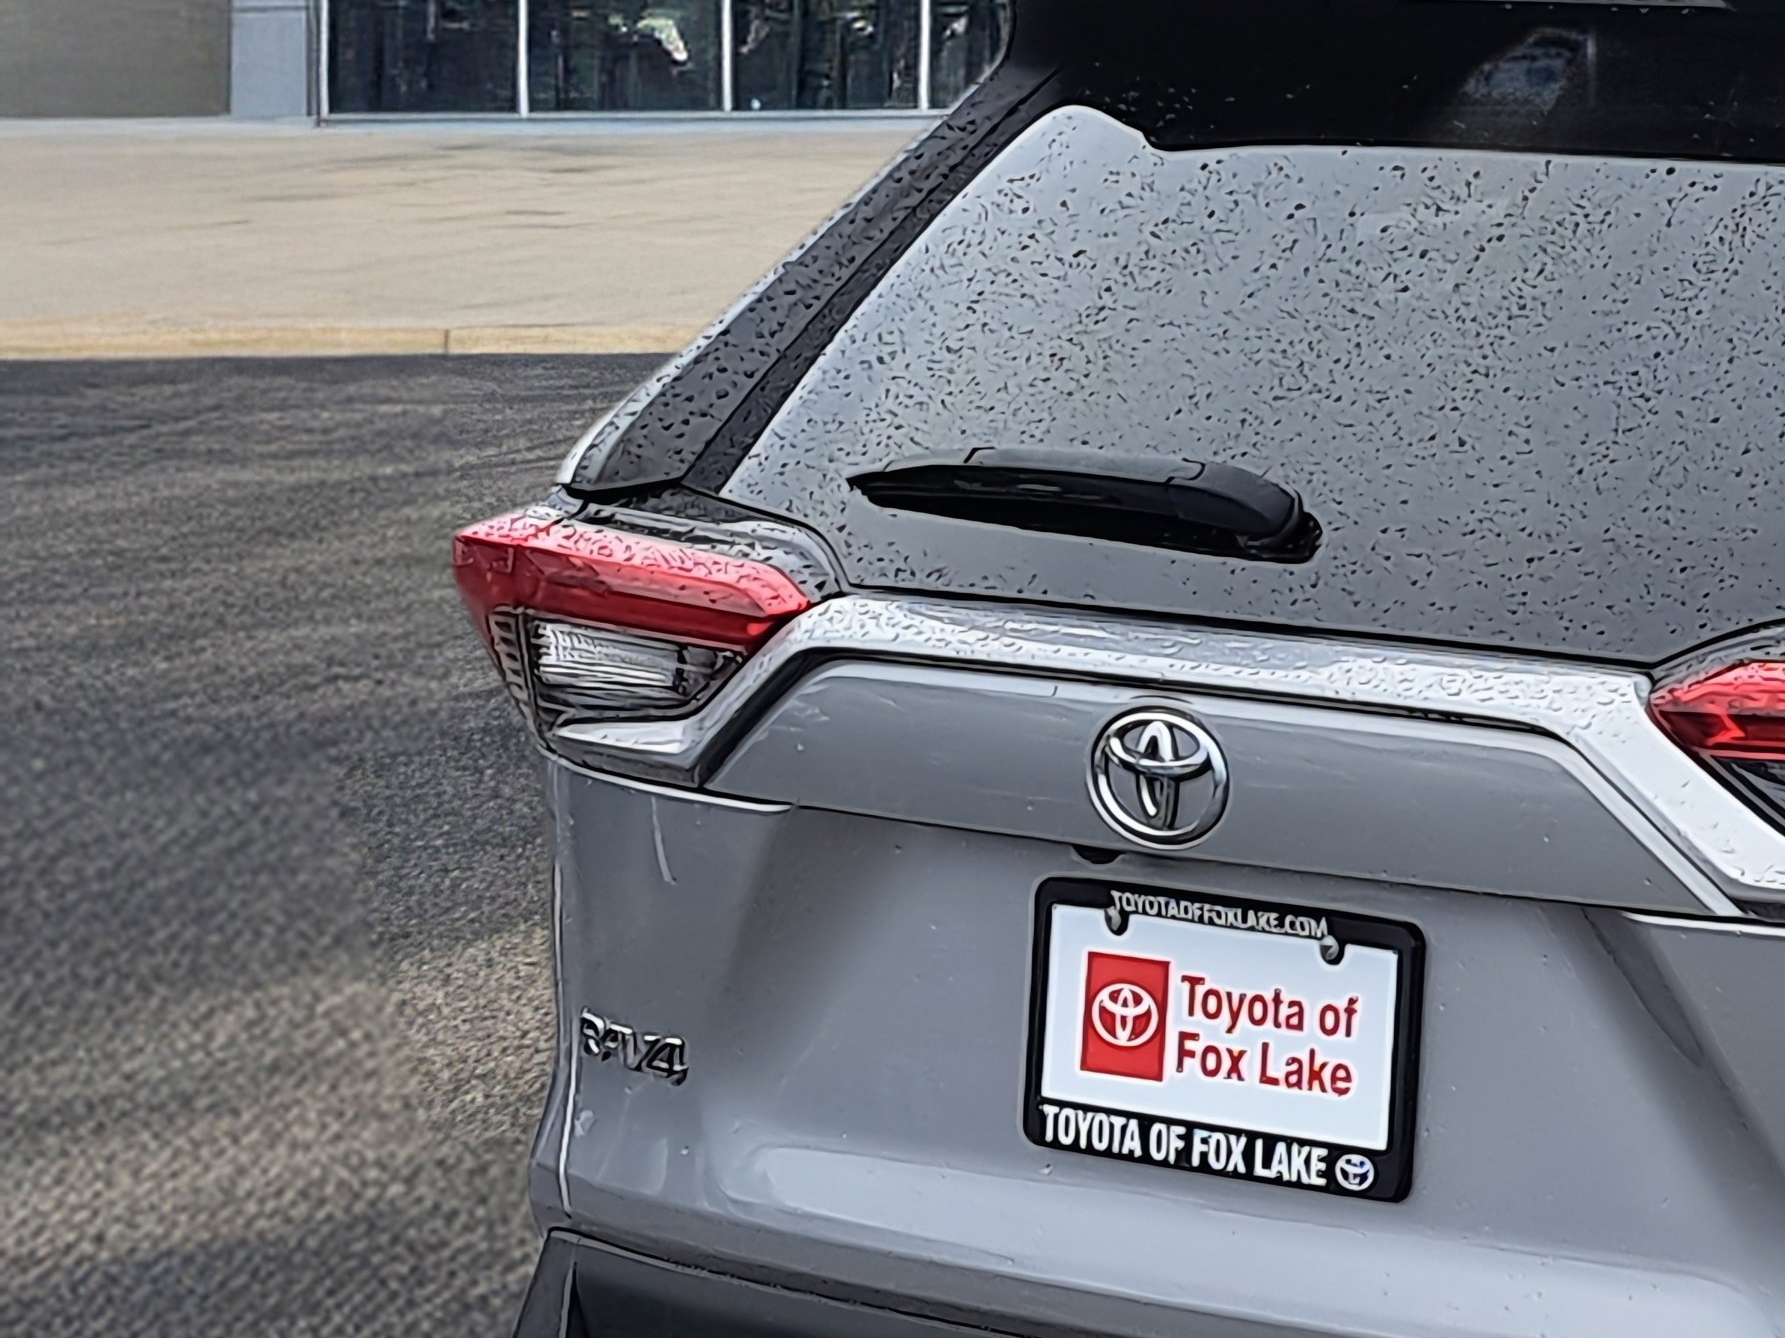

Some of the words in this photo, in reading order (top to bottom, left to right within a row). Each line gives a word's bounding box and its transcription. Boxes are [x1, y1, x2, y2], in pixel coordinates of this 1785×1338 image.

[1180, 974, 1305, 1034] Toyota
[1318, 995, 1359, 1038] of
[1175, 1030, 1248, 1082] Fox
[1258, 1041, 1353, 1097] Lake
[1041, 1103, 1143, 1158] TOYOTA
[1149, 1122, 1187, 1165] OF
[1191, 1128, 1248, 1174] FOX
[1253, 1137, 1329, 1187] LAKE
